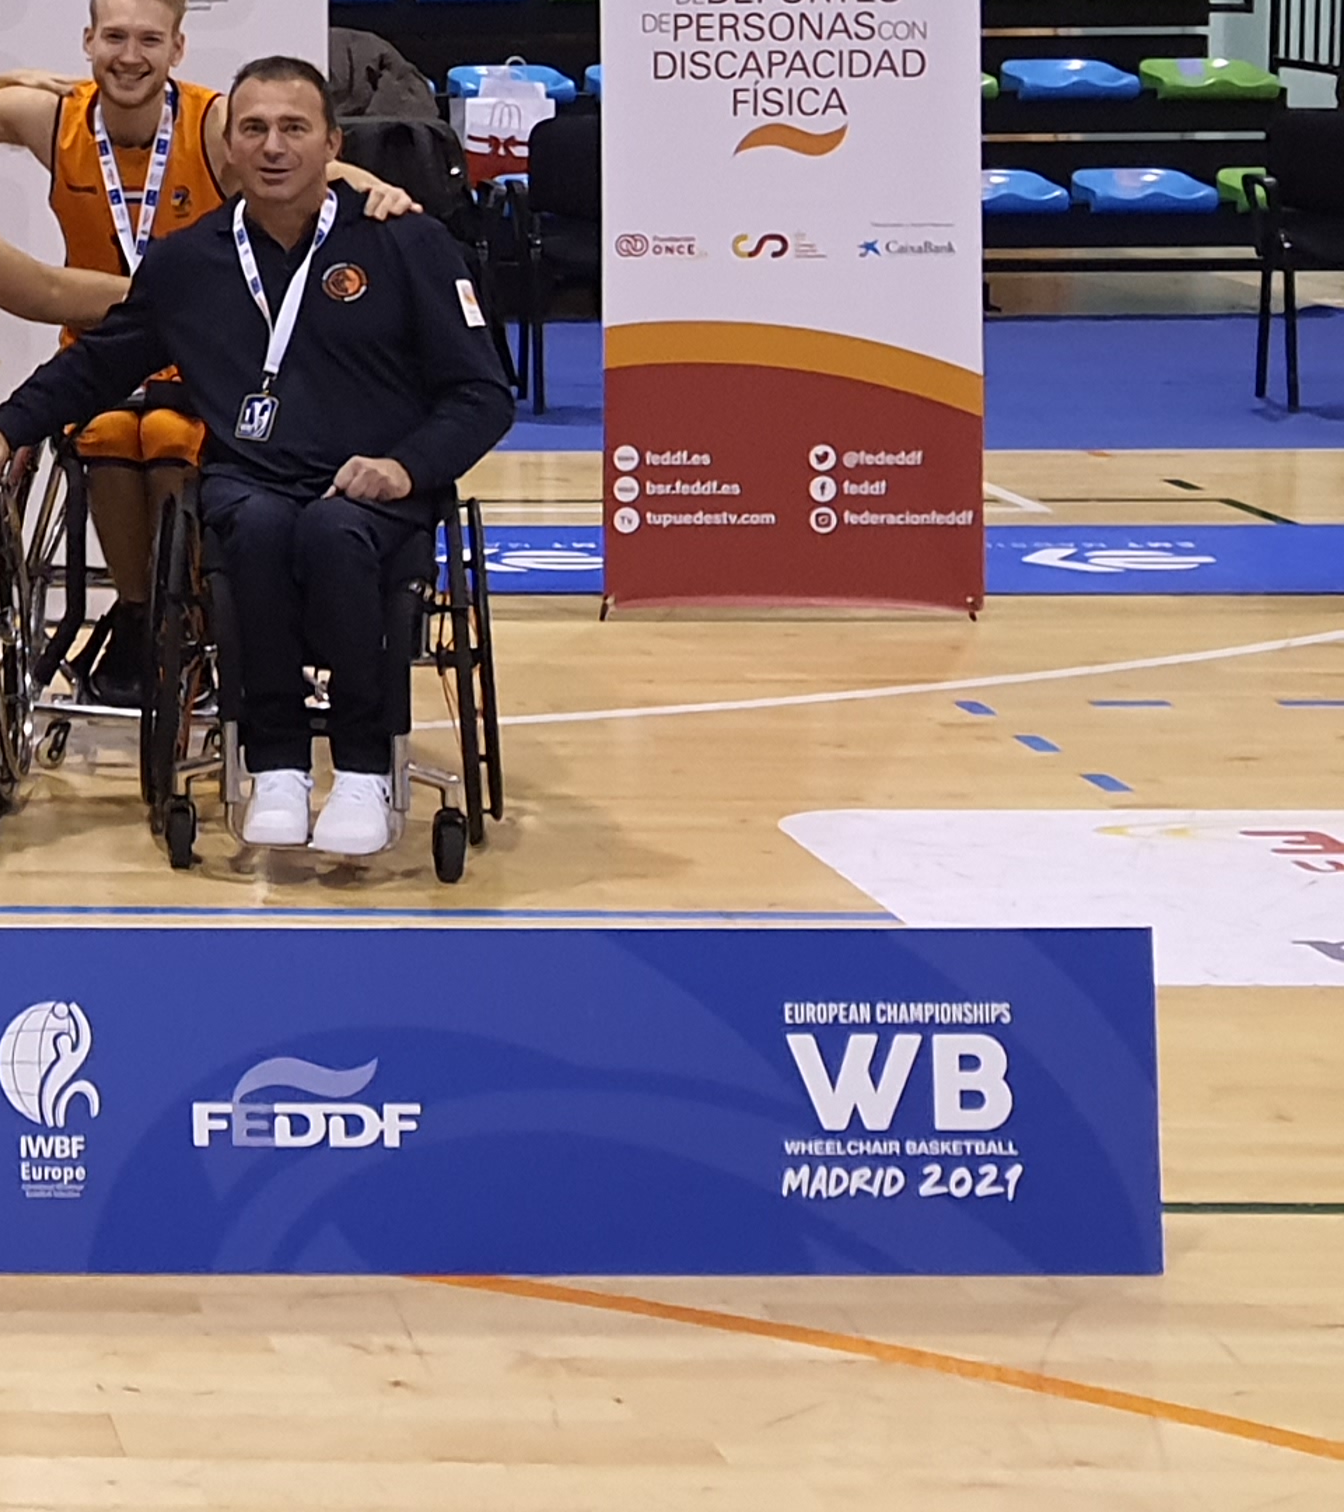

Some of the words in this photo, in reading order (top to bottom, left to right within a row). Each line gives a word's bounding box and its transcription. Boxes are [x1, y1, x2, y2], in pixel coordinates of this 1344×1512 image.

[652, 48, 927, 80] DISCAPACIDAD
[731, 80, 849, 117] FÍSICA
[652, 243, 695, 256] ONCE
[885, 239, 956, 256] CaixaBank
[783, 1002, 871, 1025] EUROPEAN
[875, 1002, 1012, 1025] CHAMPIONSHIPS
[785, 1033, 1014, 1131] WB
[192, 1102, 422, 1148] FEDDF
[20, 1134, 86, 1159] IWBF
[784, 1140, 901, 1156] WHEELCHAIR
[905, 1140, 1019, 1156] BASKETBALL
[20, 1161, 86, 1186] Europe
[782, 1163, 906, 1199] MADRID
[918, 1162, 1024, 1202] 2021
